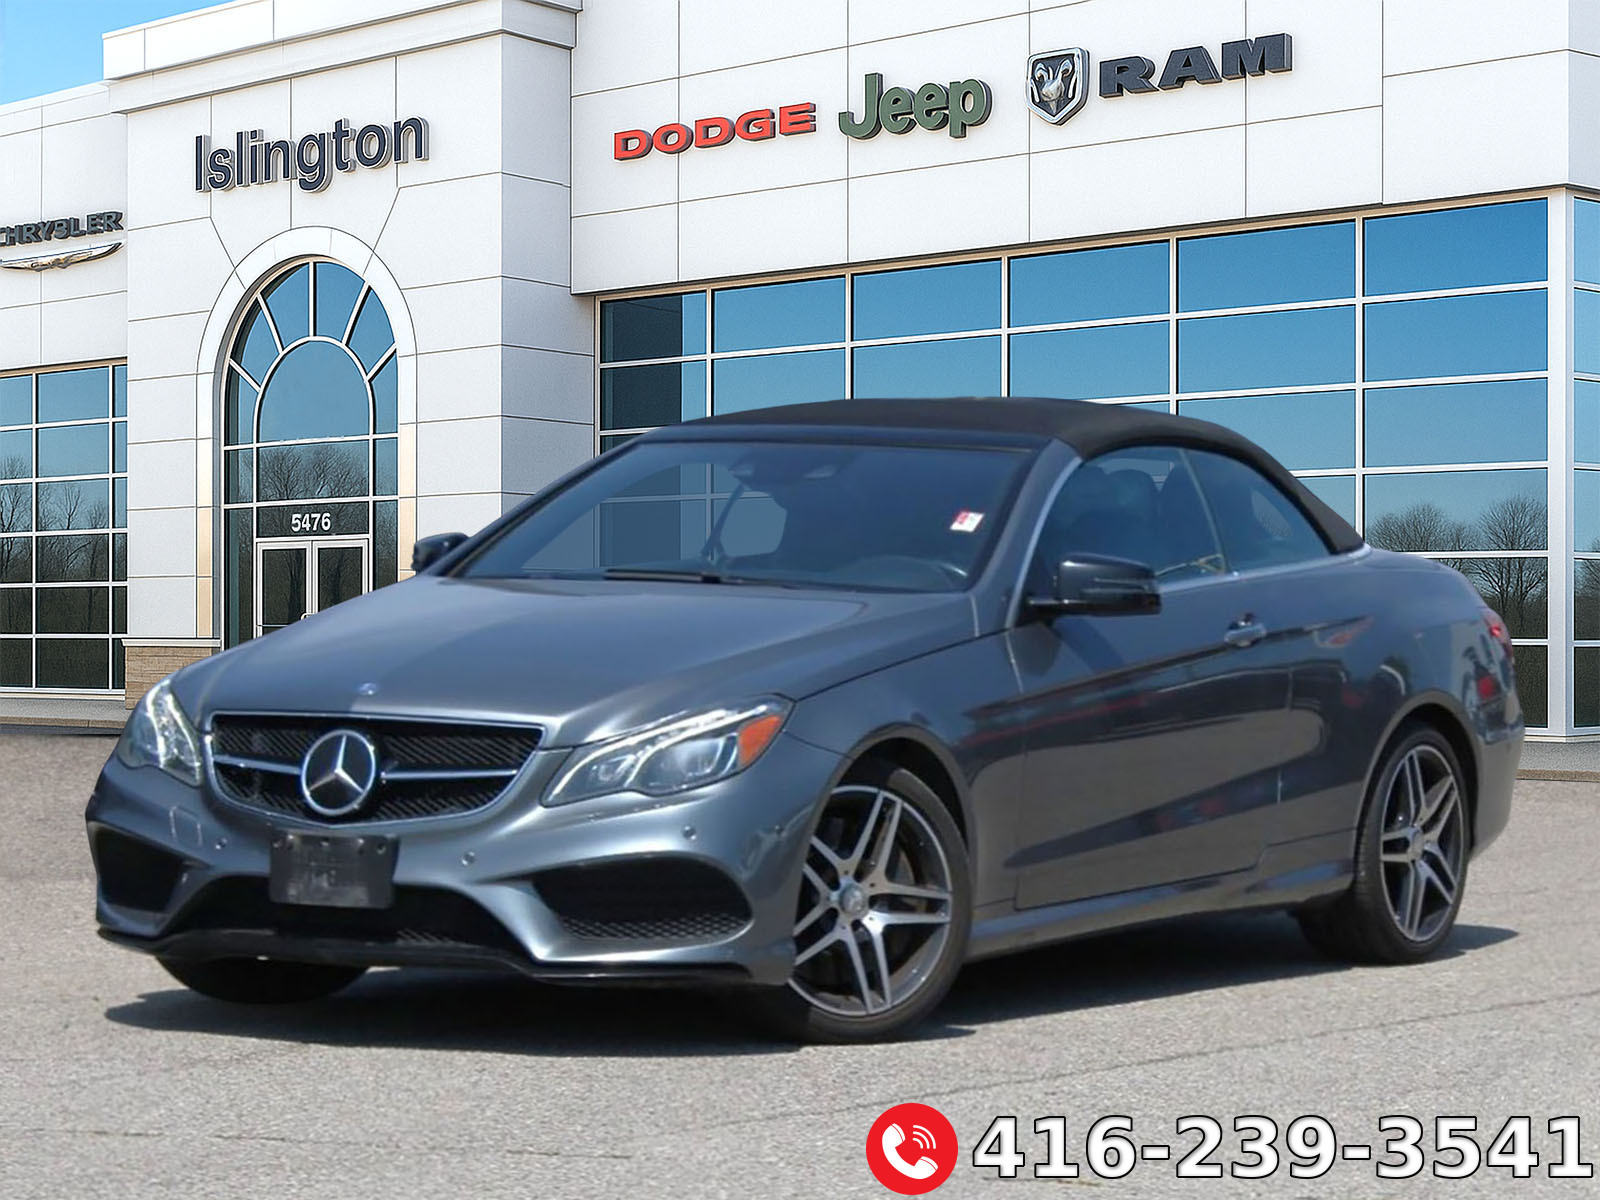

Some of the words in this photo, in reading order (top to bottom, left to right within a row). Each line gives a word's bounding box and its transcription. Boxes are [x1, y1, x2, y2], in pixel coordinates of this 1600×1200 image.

[1100, 33, 1293, 98] RAM
[614, 102, 816, 160] DODGE
[838, 72, 992, 139] Jeep
[195, 116, 429, 192] Islington
[291, 512, 332, 532] 5476
